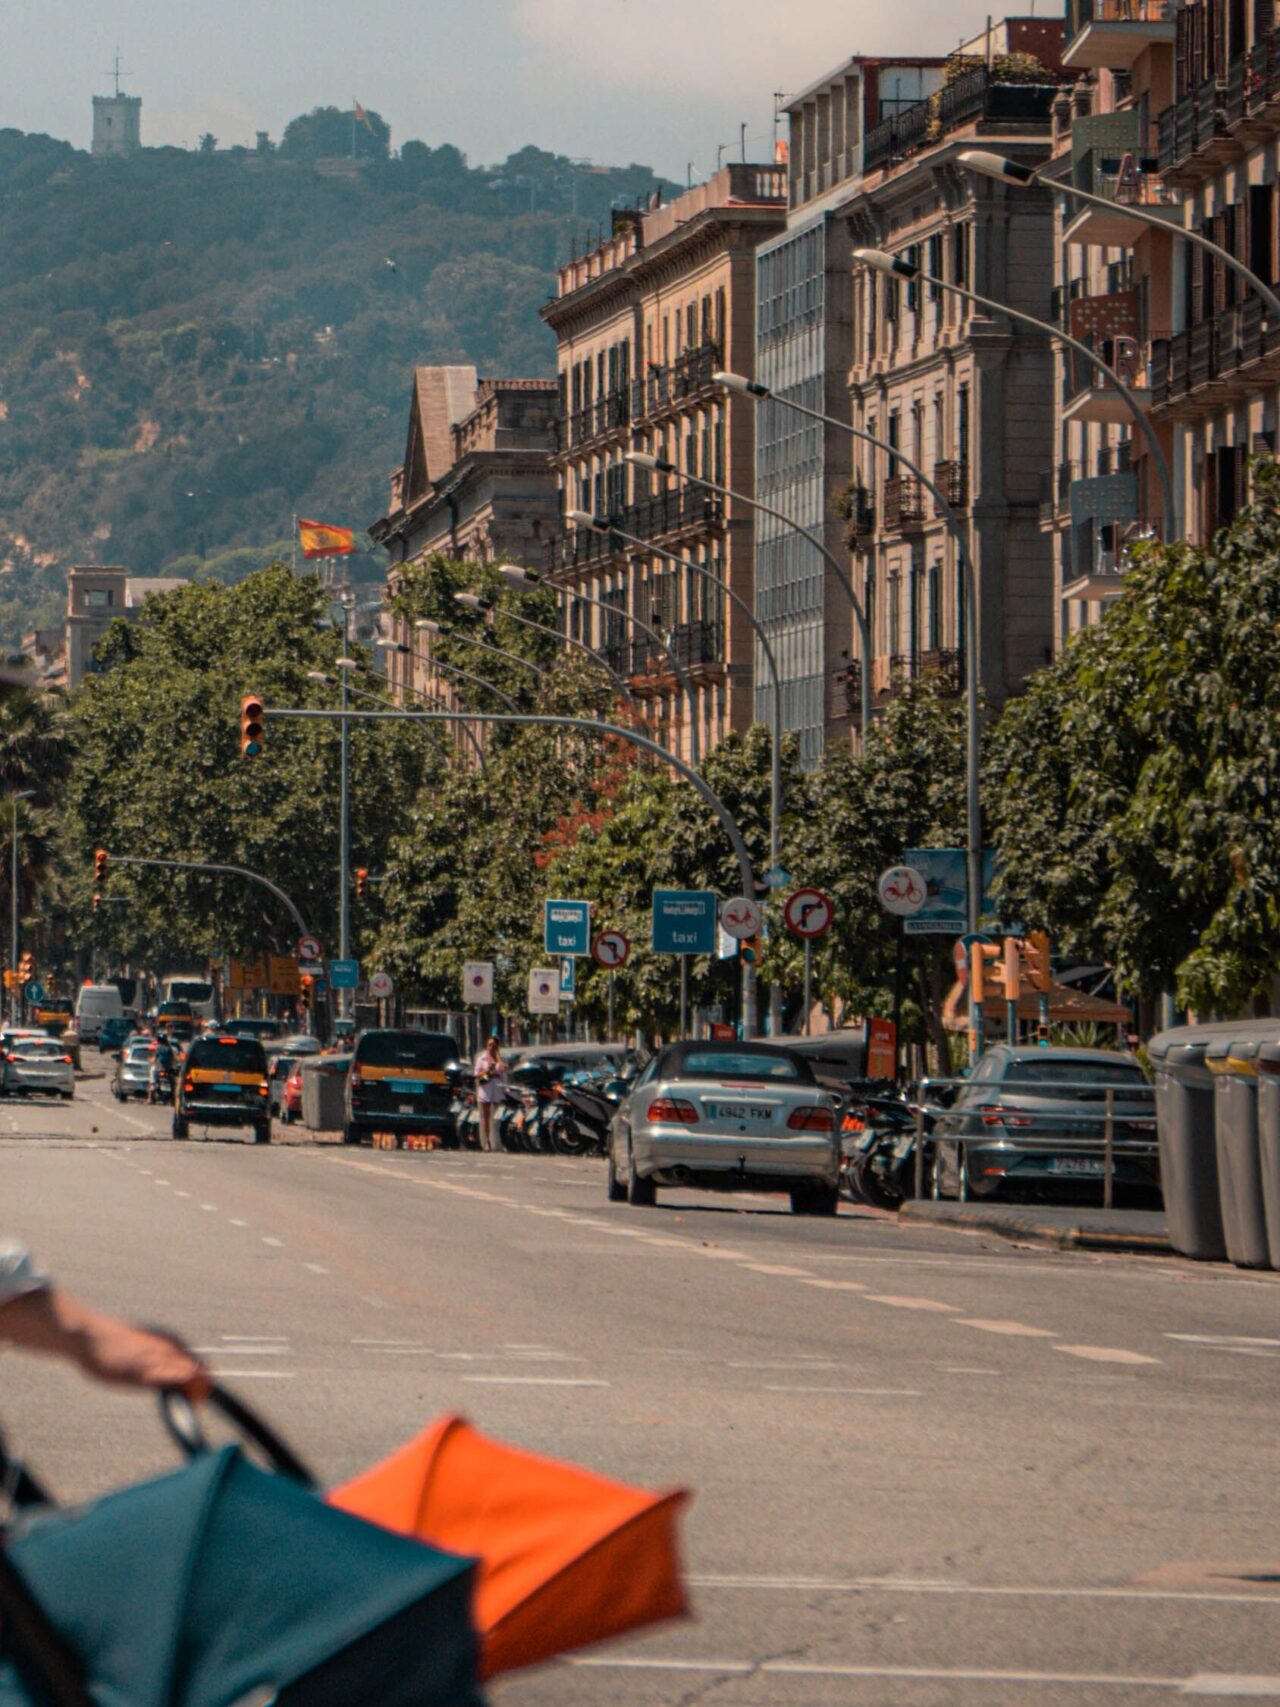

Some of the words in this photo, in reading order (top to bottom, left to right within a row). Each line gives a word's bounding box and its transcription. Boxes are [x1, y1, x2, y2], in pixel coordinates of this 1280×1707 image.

[558, 935, 576, 947] taxi
[672, 931, 698, 944] taxi
[562, 960, 570, 987] P
